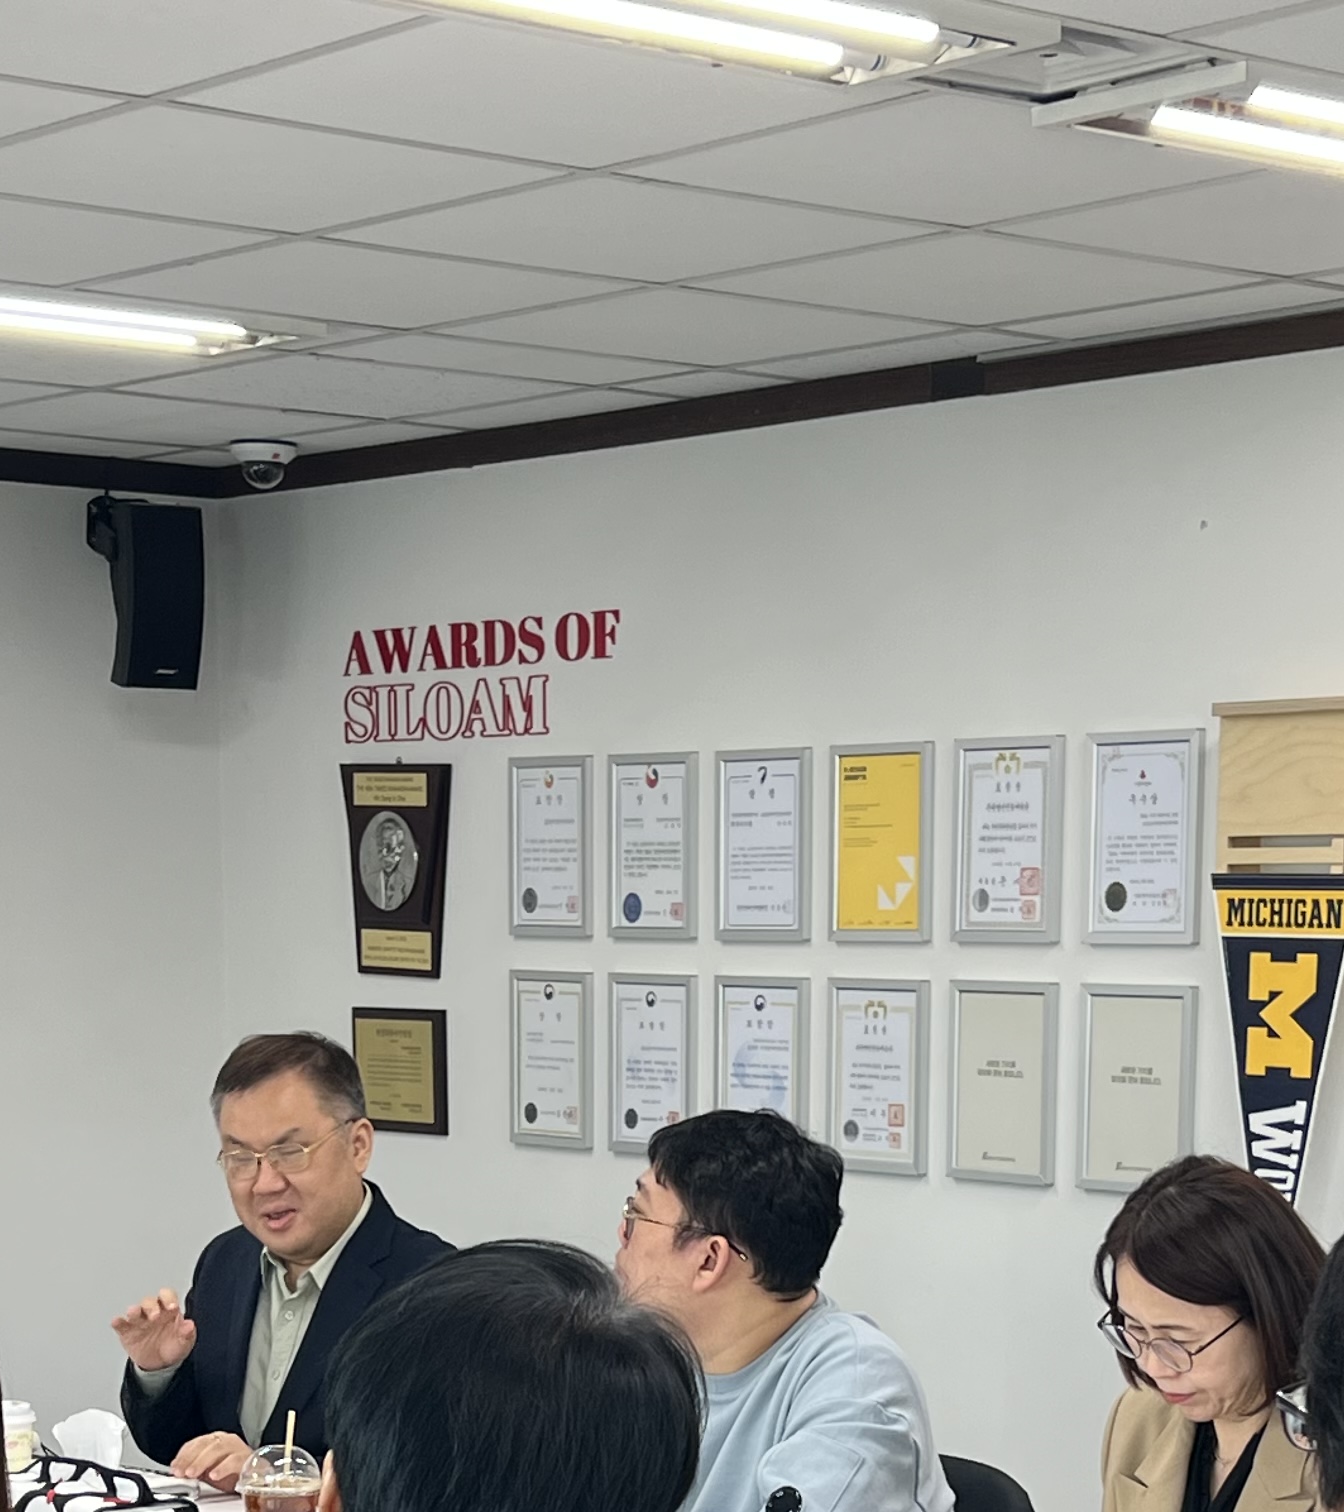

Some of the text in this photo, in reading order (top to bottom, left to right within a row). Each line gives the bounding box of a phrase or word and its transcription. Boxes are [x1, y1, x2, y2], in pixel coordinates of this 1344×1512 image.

[343, 609, 620, 676] AWARDS OF
[344, 675, 550, 744] SILOAM
[1225, 897, 1344, 929] MICHIGAN
[1245, 951, 1318, 1079] M
[1248, 1100, 1308, 1201] WO
